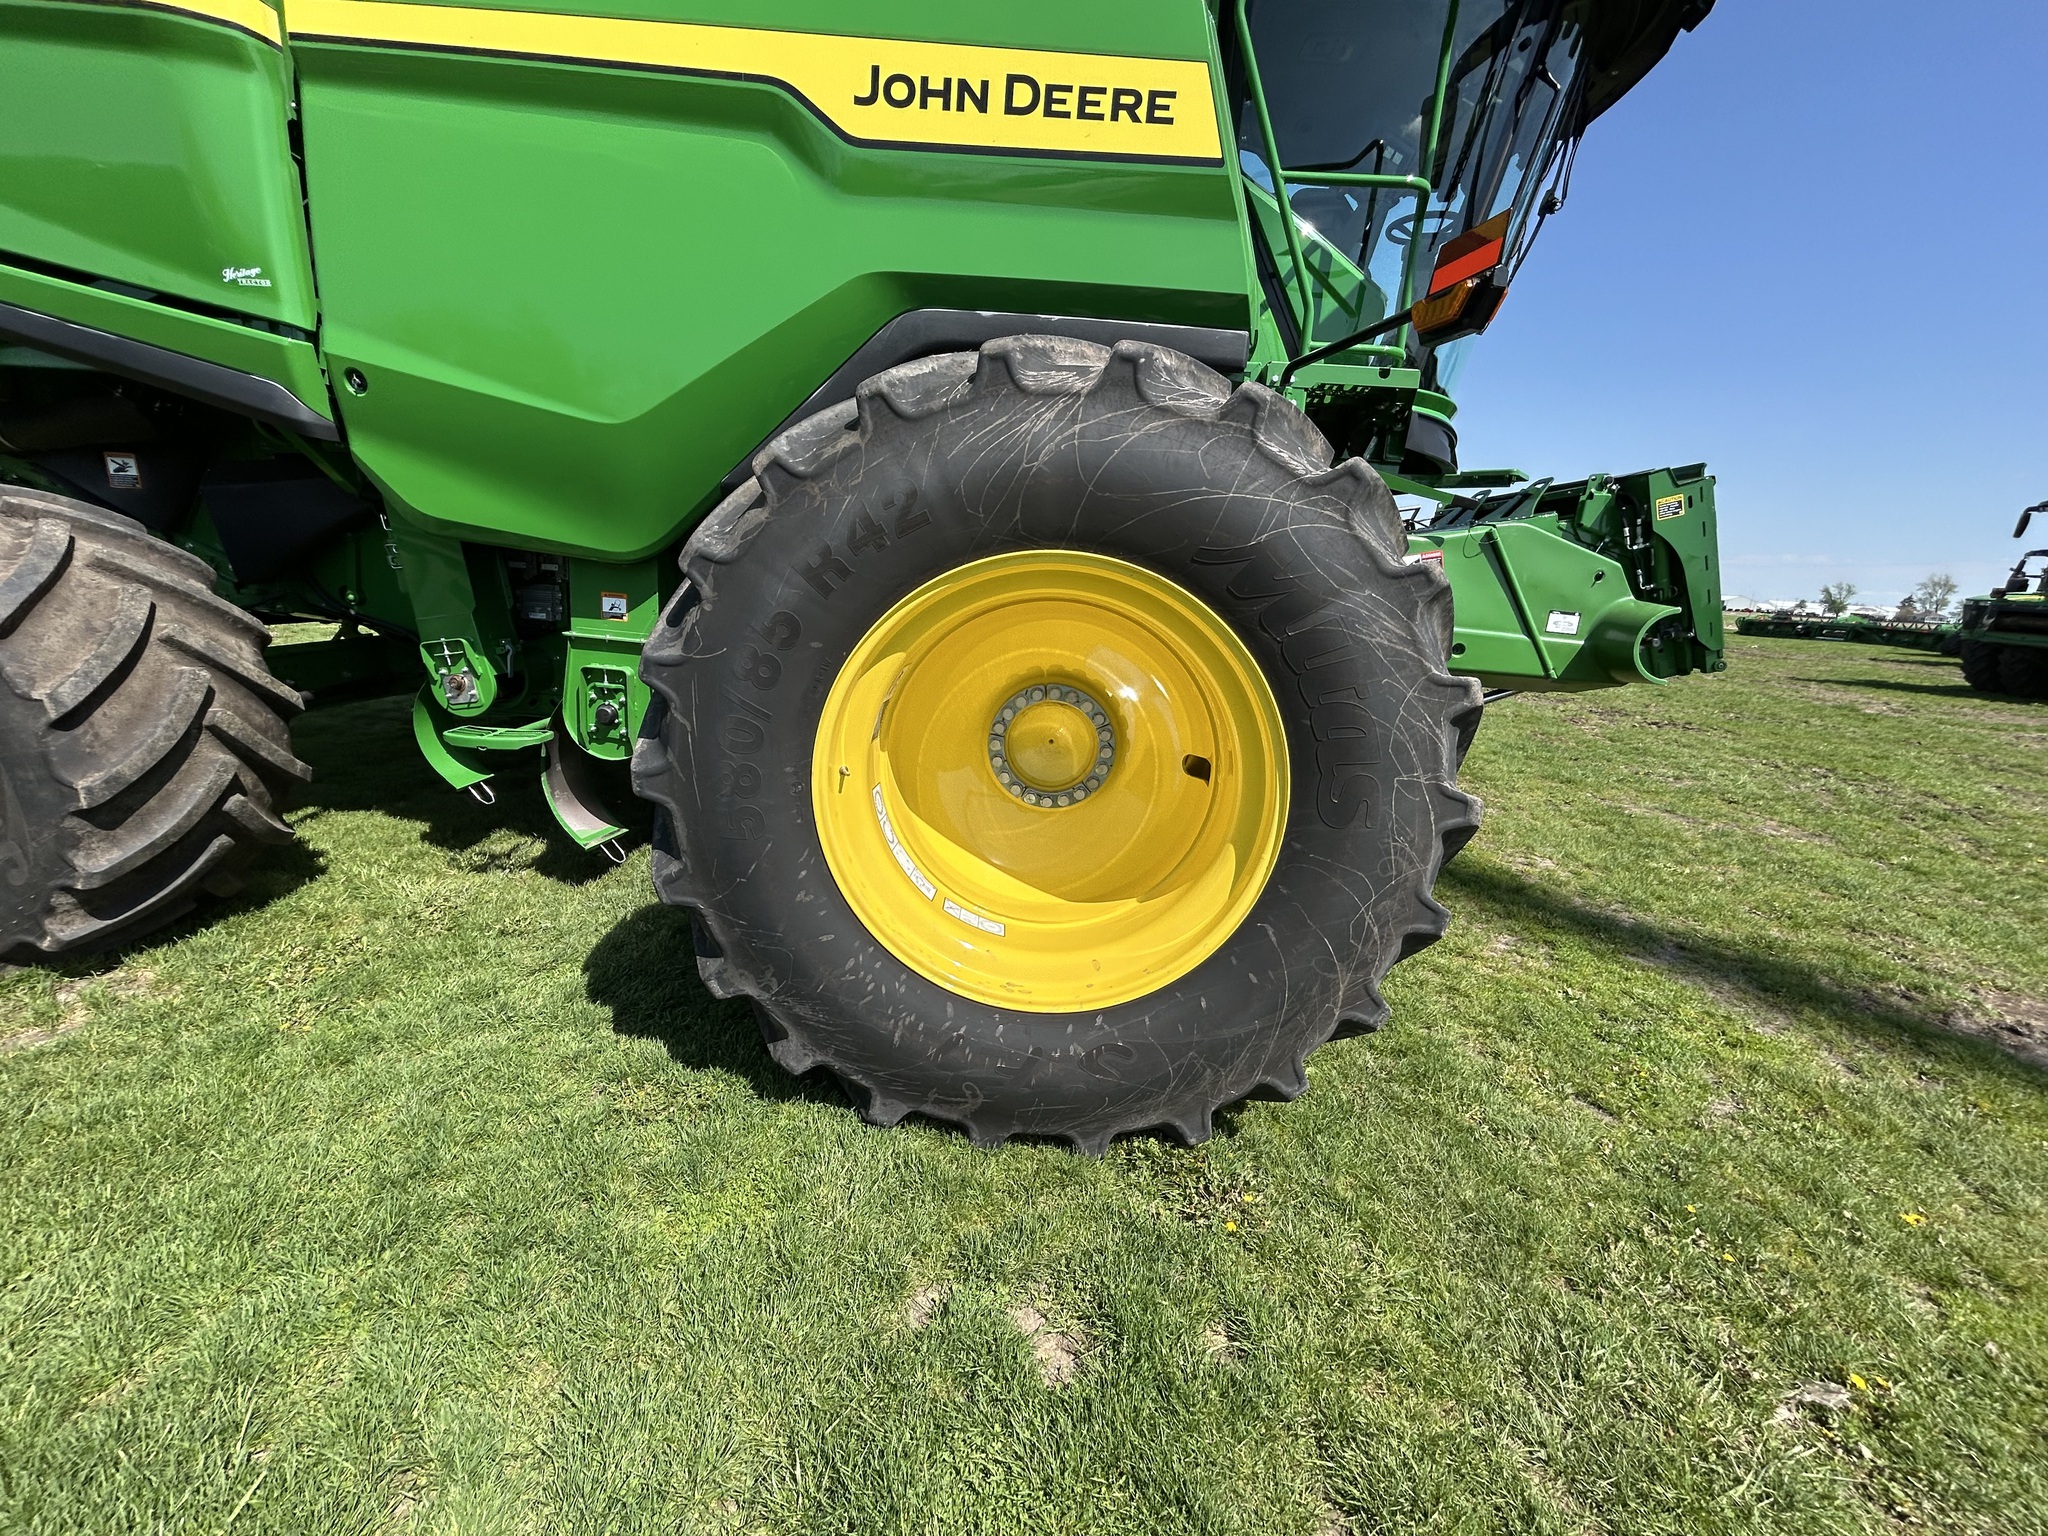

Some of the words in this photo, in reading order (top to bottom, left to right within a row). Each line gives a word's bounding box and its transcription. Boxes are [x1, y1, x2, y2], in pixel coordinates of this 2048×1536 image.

[853, 64, 990, 115] JOHN
[1003, 73, 1178, 125] DEERE
[222, 267, 262, 282] Heritage
[718, 610, 803, 841] 580/85
